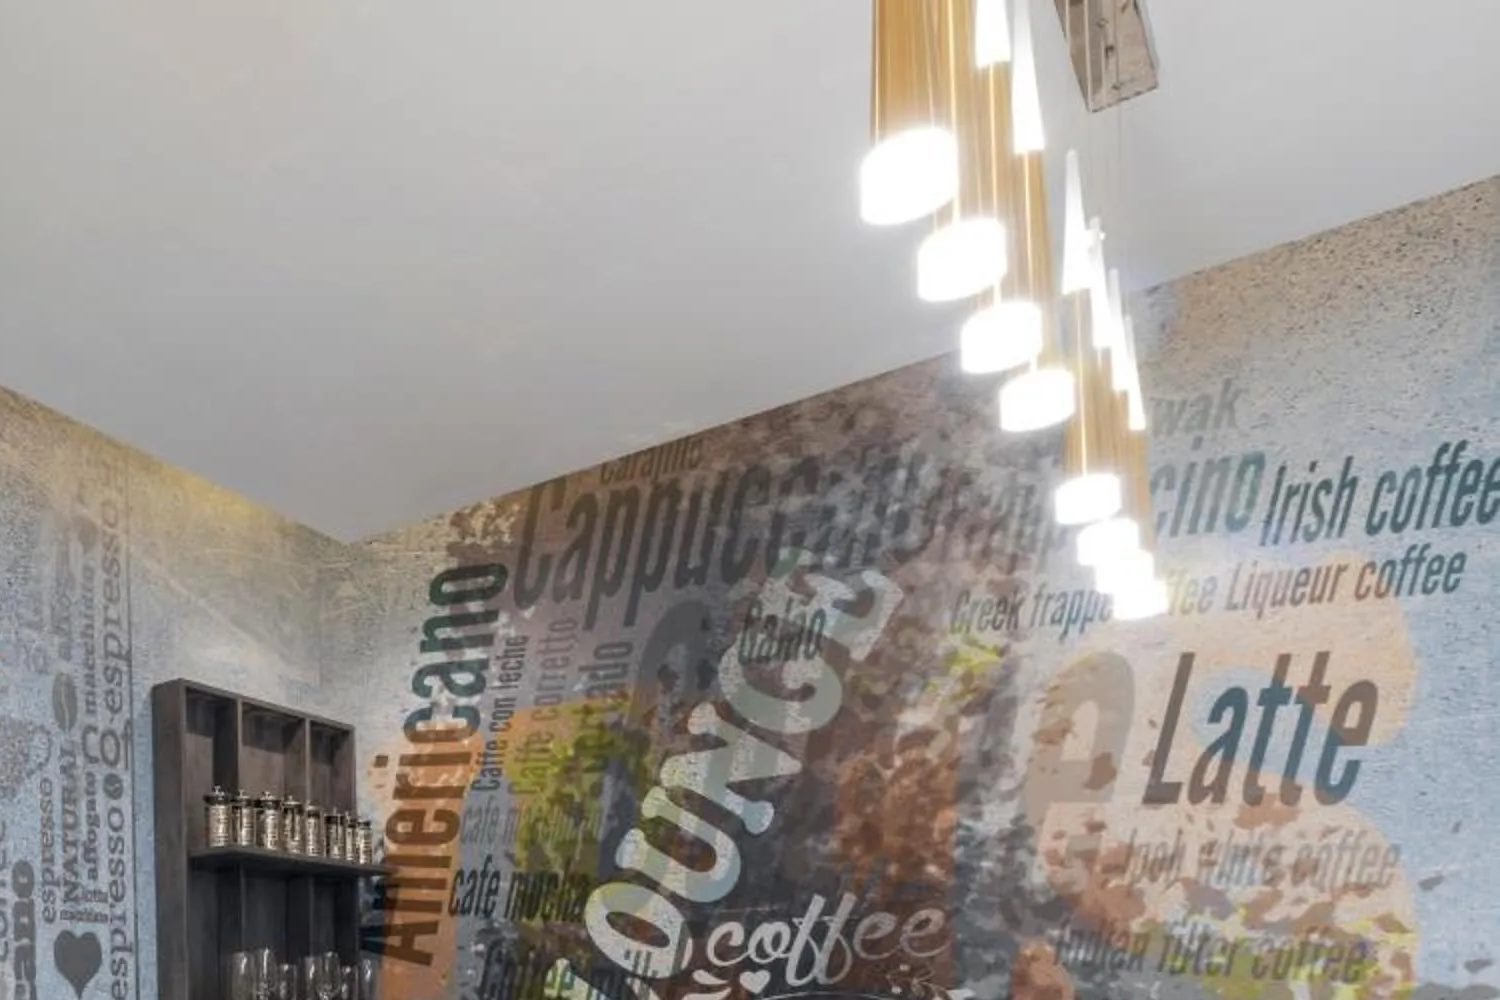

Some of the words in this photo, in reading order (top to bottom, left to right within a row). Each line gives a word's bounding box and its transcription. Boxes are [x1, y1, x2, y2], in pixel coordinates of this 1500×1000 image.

[1260, 455, 1359, 547] Irish
[1365, 439, 1500, 537] coffee
[1223, 559, 1350, 620] Liqueur
[1354, 542, 1468, 602] coffee
[1141, 649, 1381, 806] Latte
[106, 806, 133, 1000] espresso
[705, 892, 953, 987] coffee
